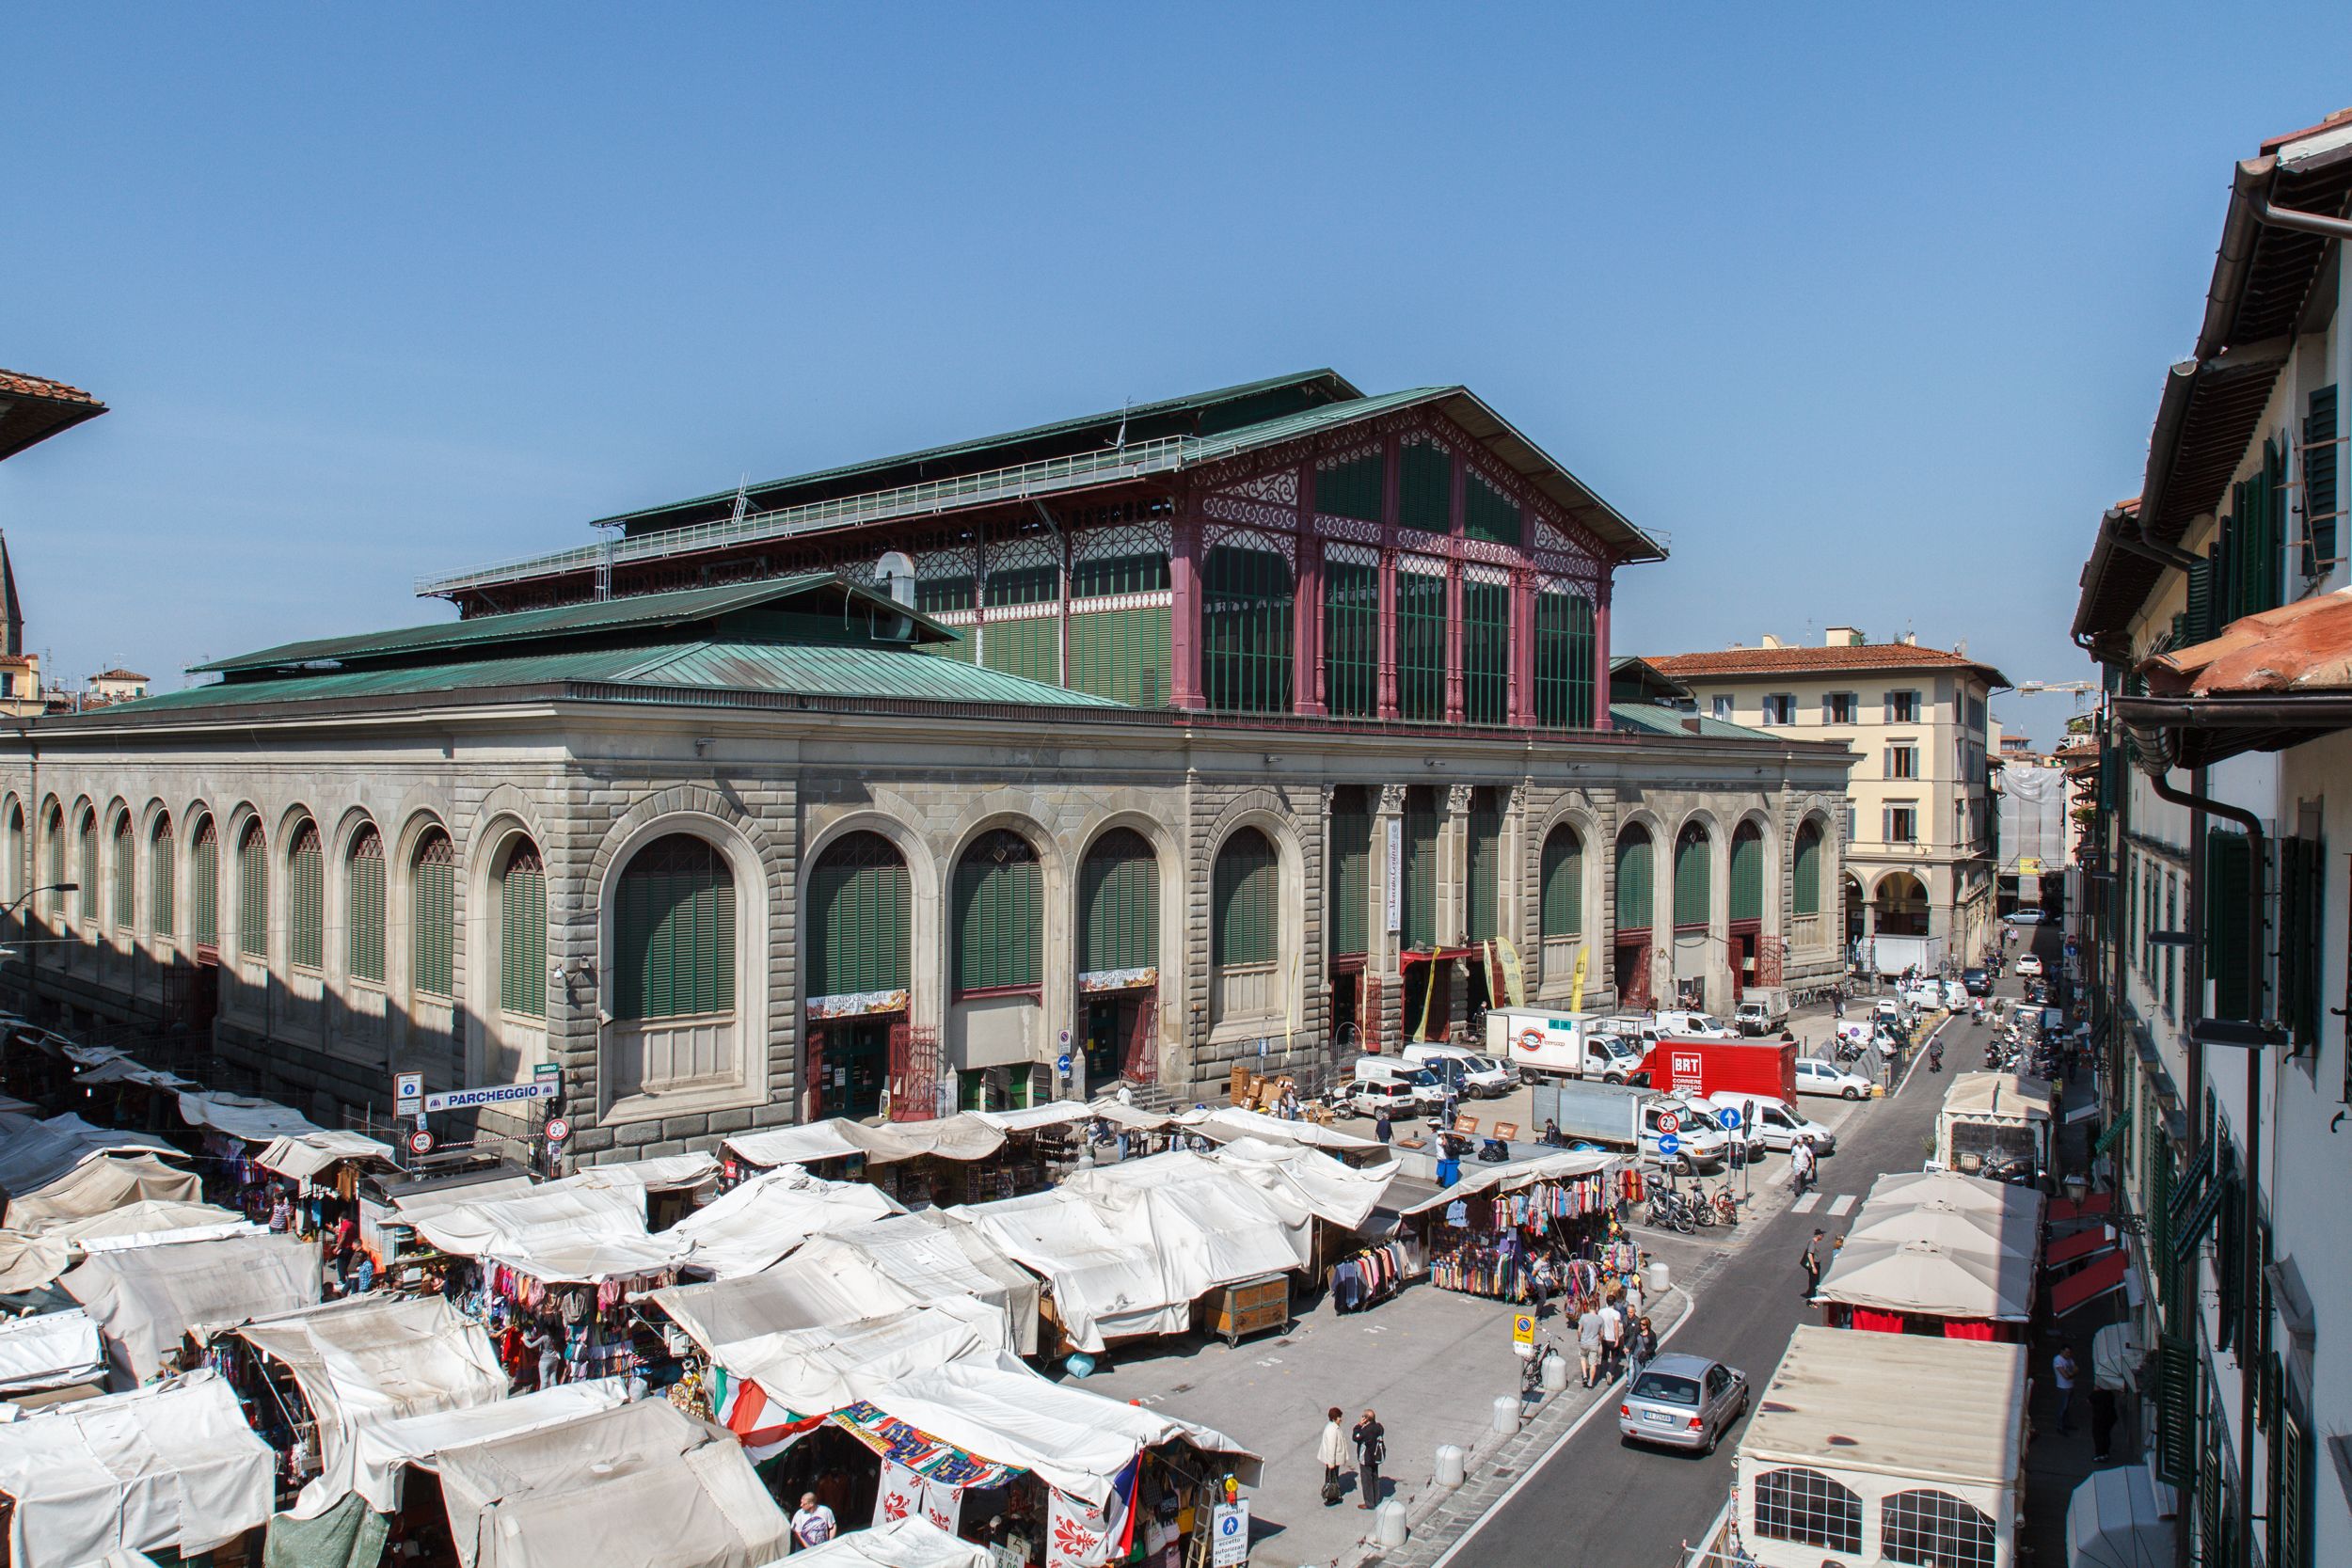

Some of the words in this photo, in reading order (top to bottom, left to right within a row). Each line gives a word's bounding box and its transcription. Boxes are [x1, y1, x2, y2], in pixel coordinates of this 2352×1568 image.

[817, 995, 851, 1006] MERCATO
[853, 992, 887, 1002] CENTRALE
[828, 1002, 855, 1011] FIRENZE
[1675, 1057, 1699, 1072] BRT
[449, 1085, 538, 1106] PARCHEGGIO
[1217, 1507, 1245, 1519] pedonale
[1218, 1537, 1241, 1547] eccetto
[993, 1545, 1013, 1560] TUTTO
[1215, 1544, 1245, 1555] autorizzati
